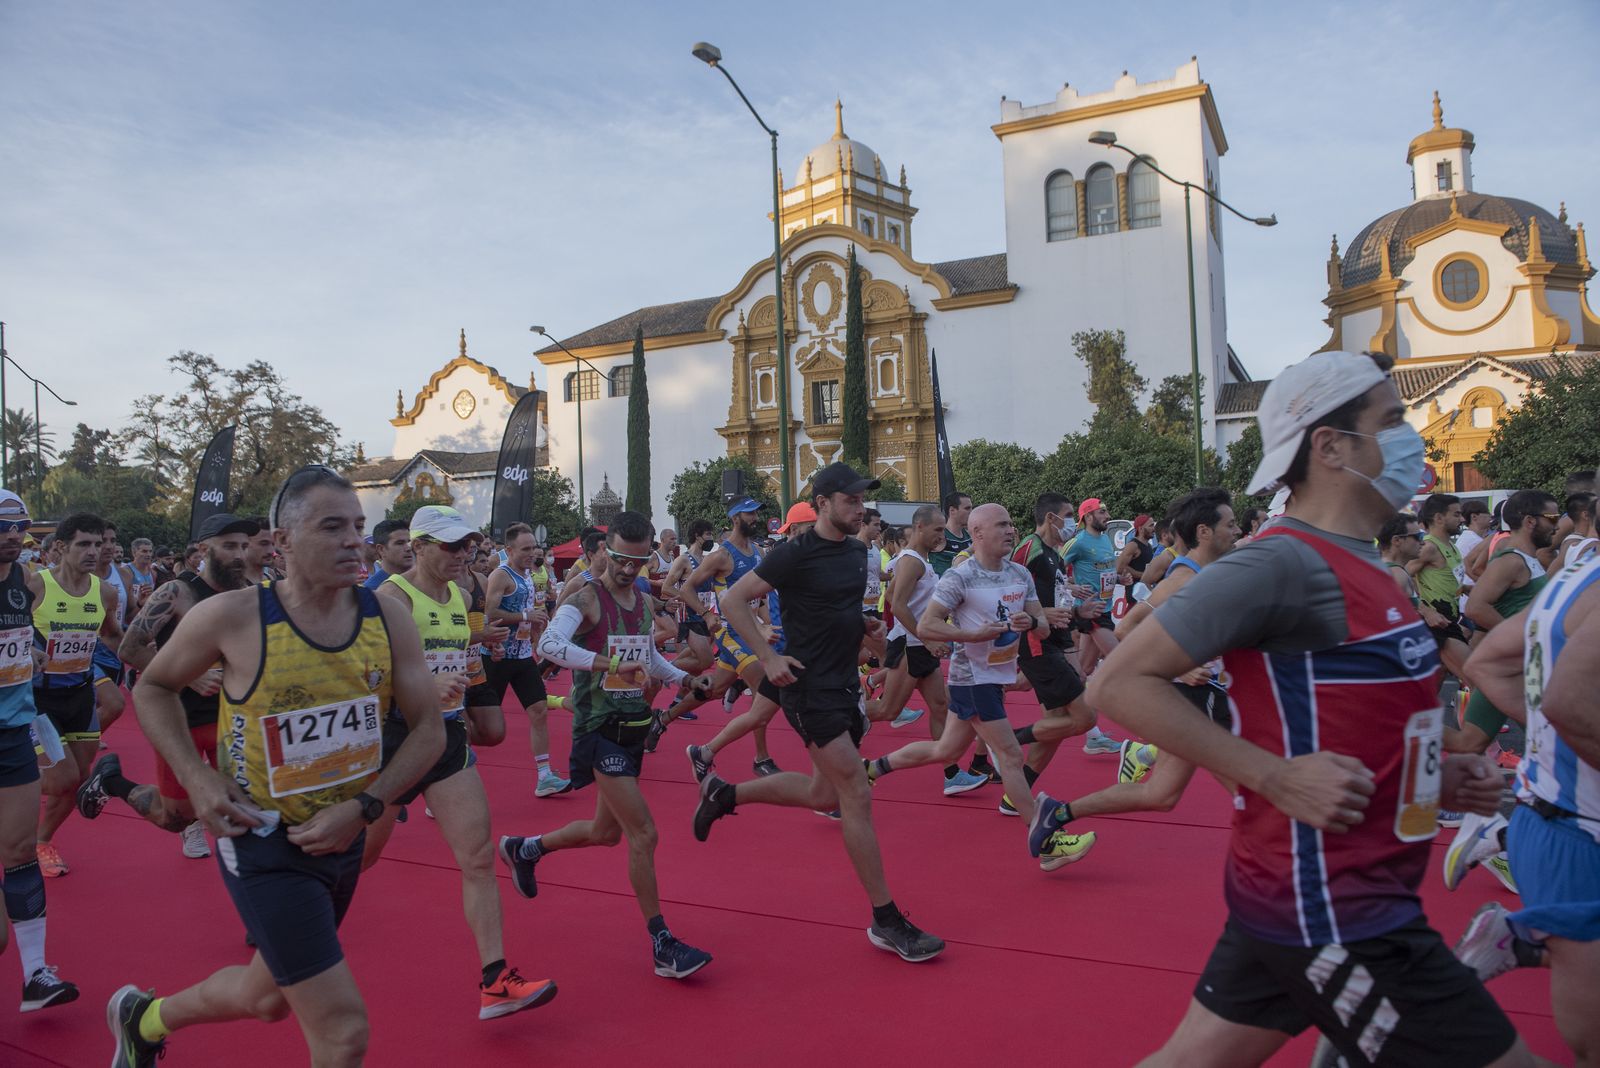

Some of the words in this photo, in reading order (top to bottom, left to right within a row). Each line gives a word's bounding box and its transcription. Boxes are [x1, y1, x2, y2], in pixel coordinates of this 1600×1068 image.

[502, 464, 528, 486] edp
[200, 488, 224, 507] edp
[54, 640, 89, 654] 1294
[619, 648, 642, 661] 747
[278, 704, 361, 745] 1274
[230, 715, 250, 789] UNNING
